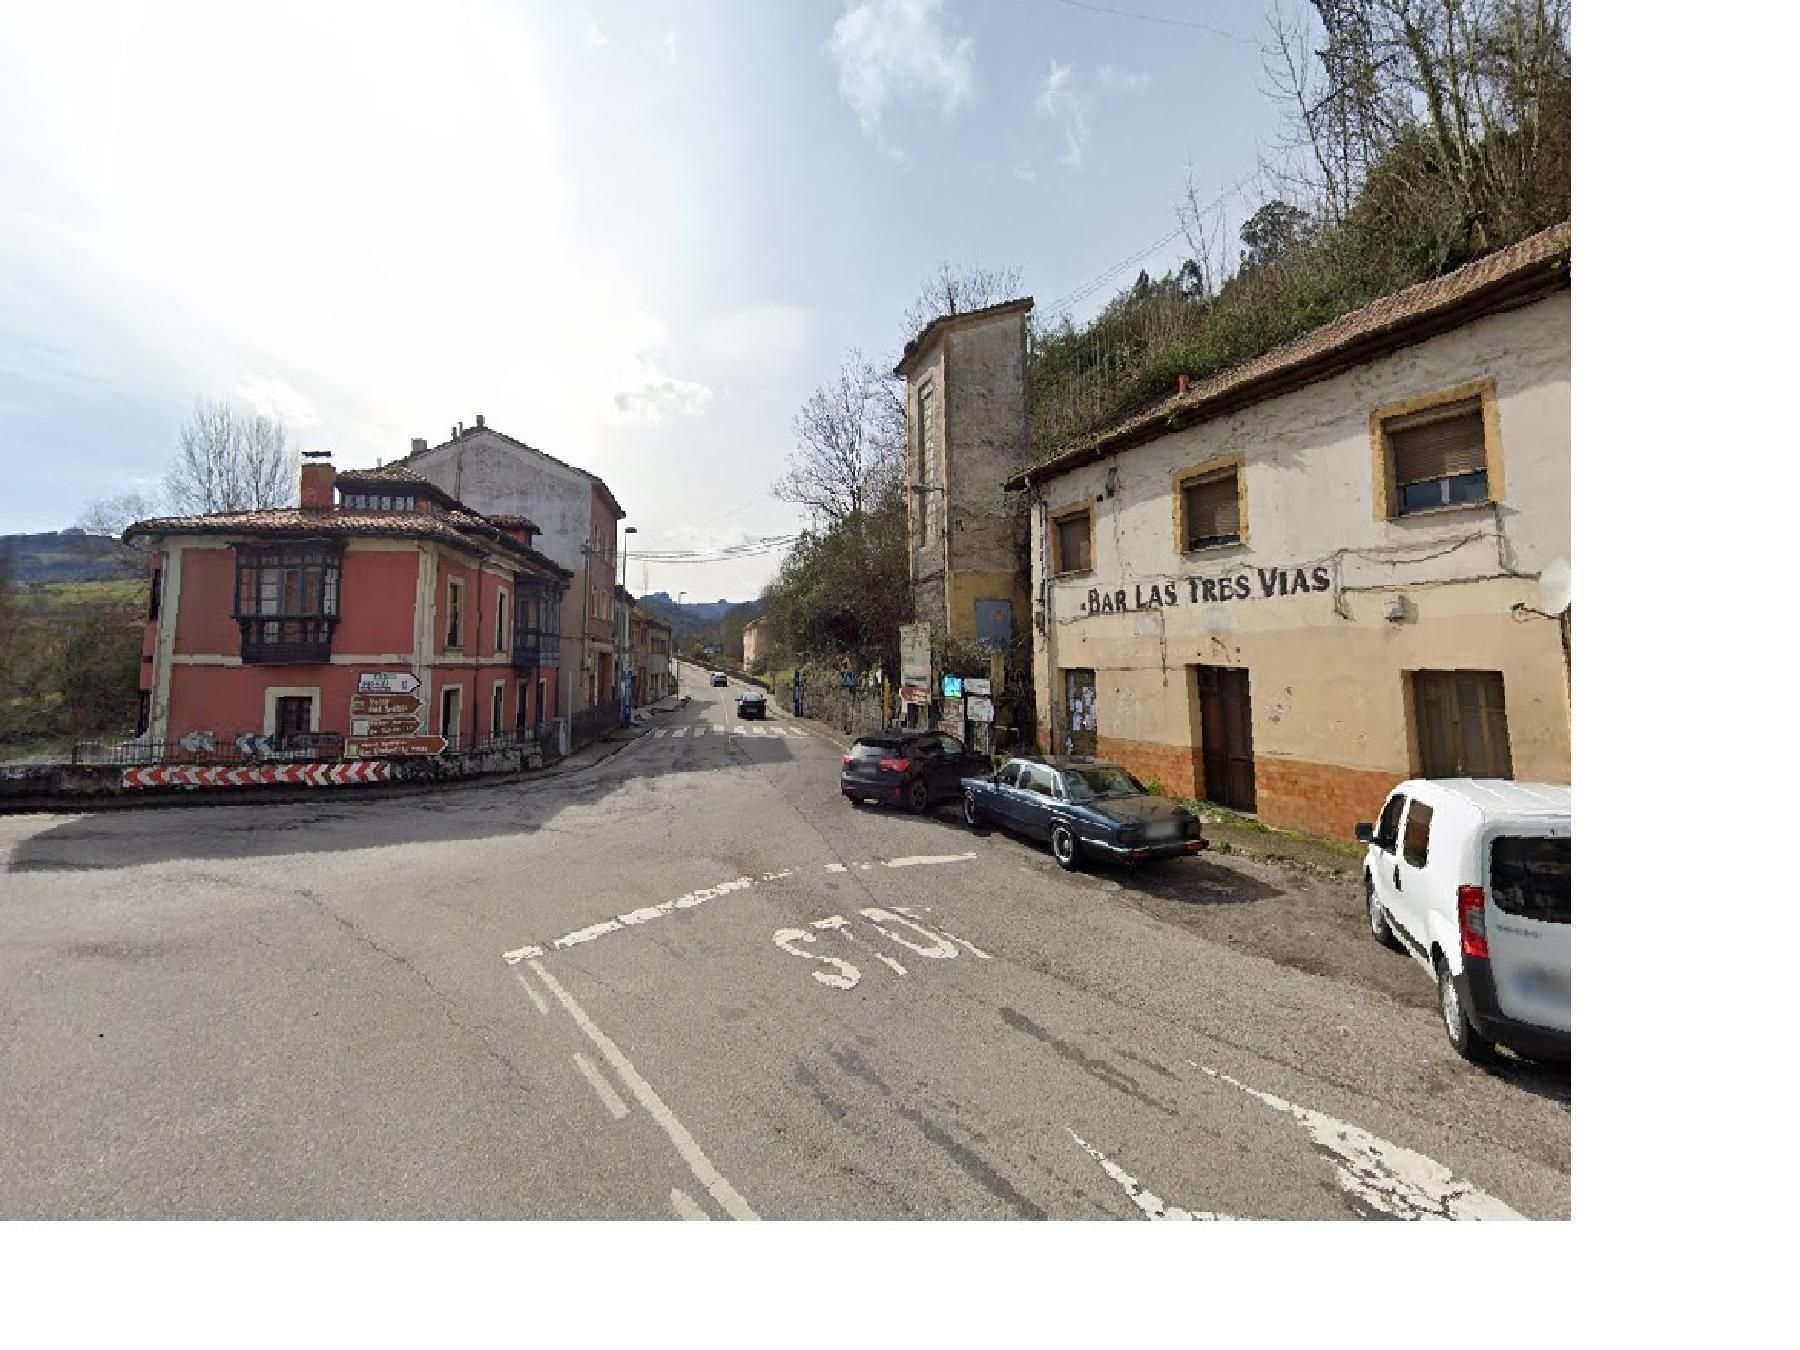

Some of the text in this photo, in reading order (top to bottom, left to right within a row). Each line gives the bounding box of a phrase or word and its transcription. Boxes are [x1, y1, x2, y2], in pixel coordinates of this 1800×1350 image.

[1088, 567, 1331, 614] BAR LAS TRES VIAS
